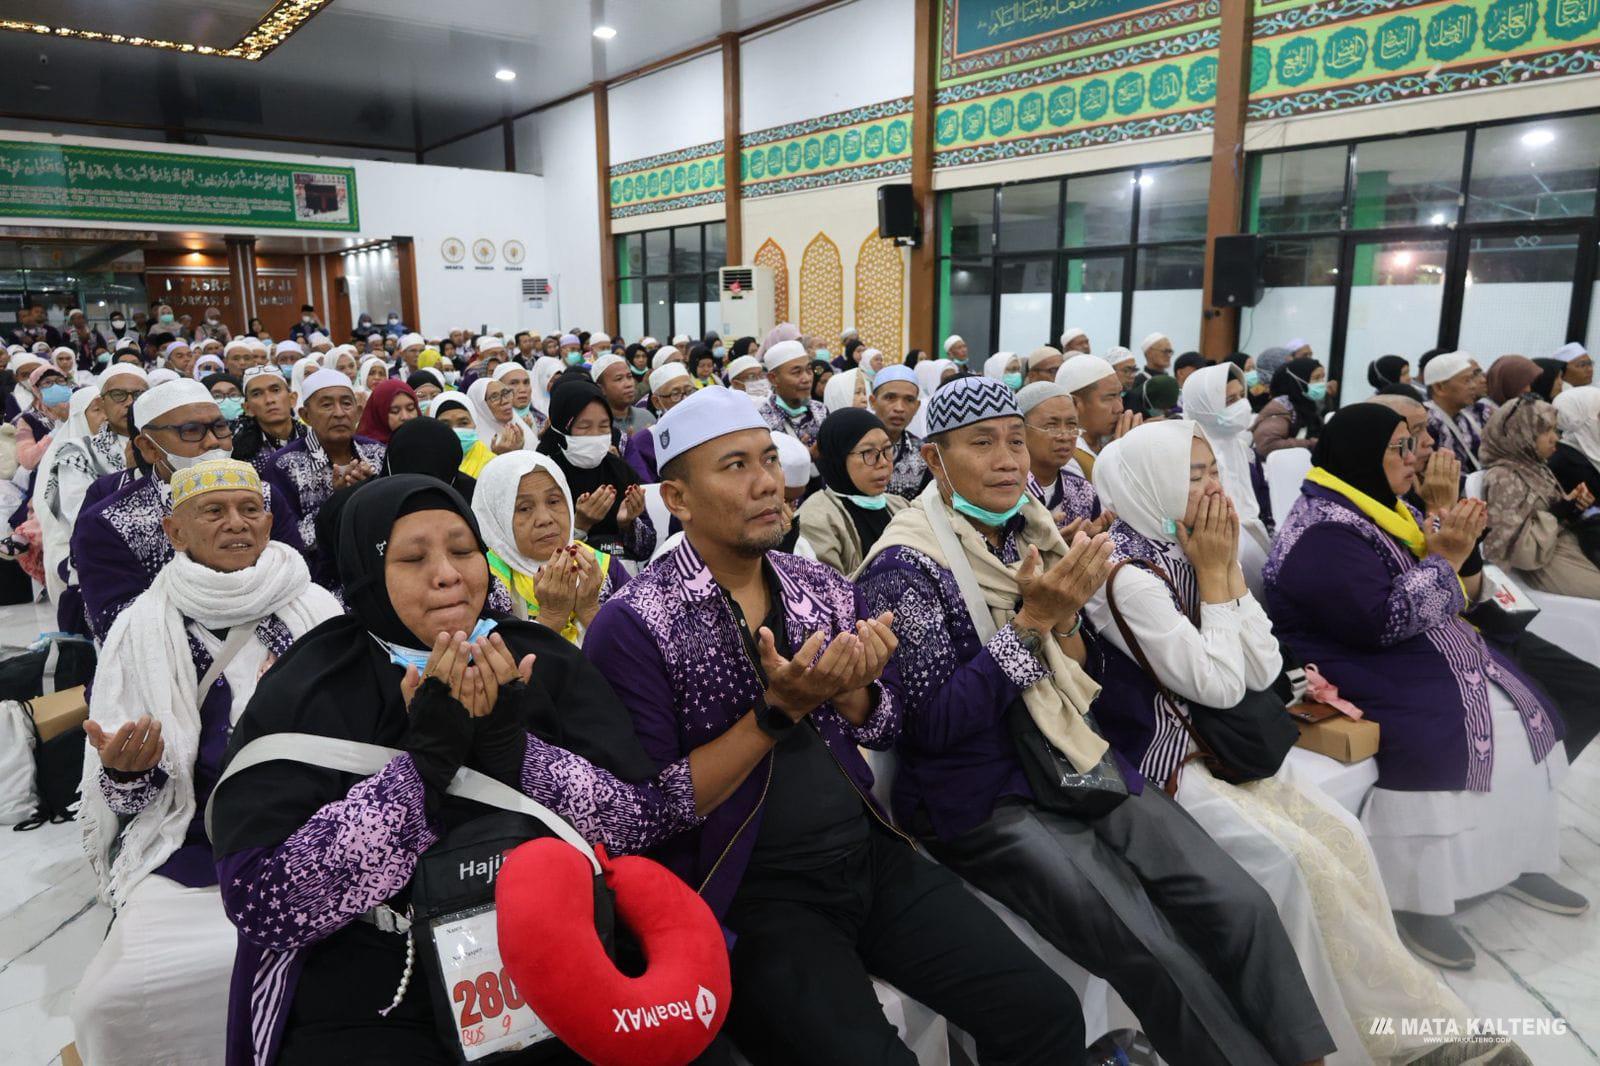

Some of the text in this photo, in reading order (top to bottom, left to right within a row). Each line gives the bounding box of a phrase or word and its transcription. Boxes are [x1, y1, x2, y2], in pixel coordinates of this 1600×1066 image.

[459, 854, 500, 884] Haji
[502, 1014, 512, 1037] 9
[612, 1000, 694, 1033] RoaMAX
